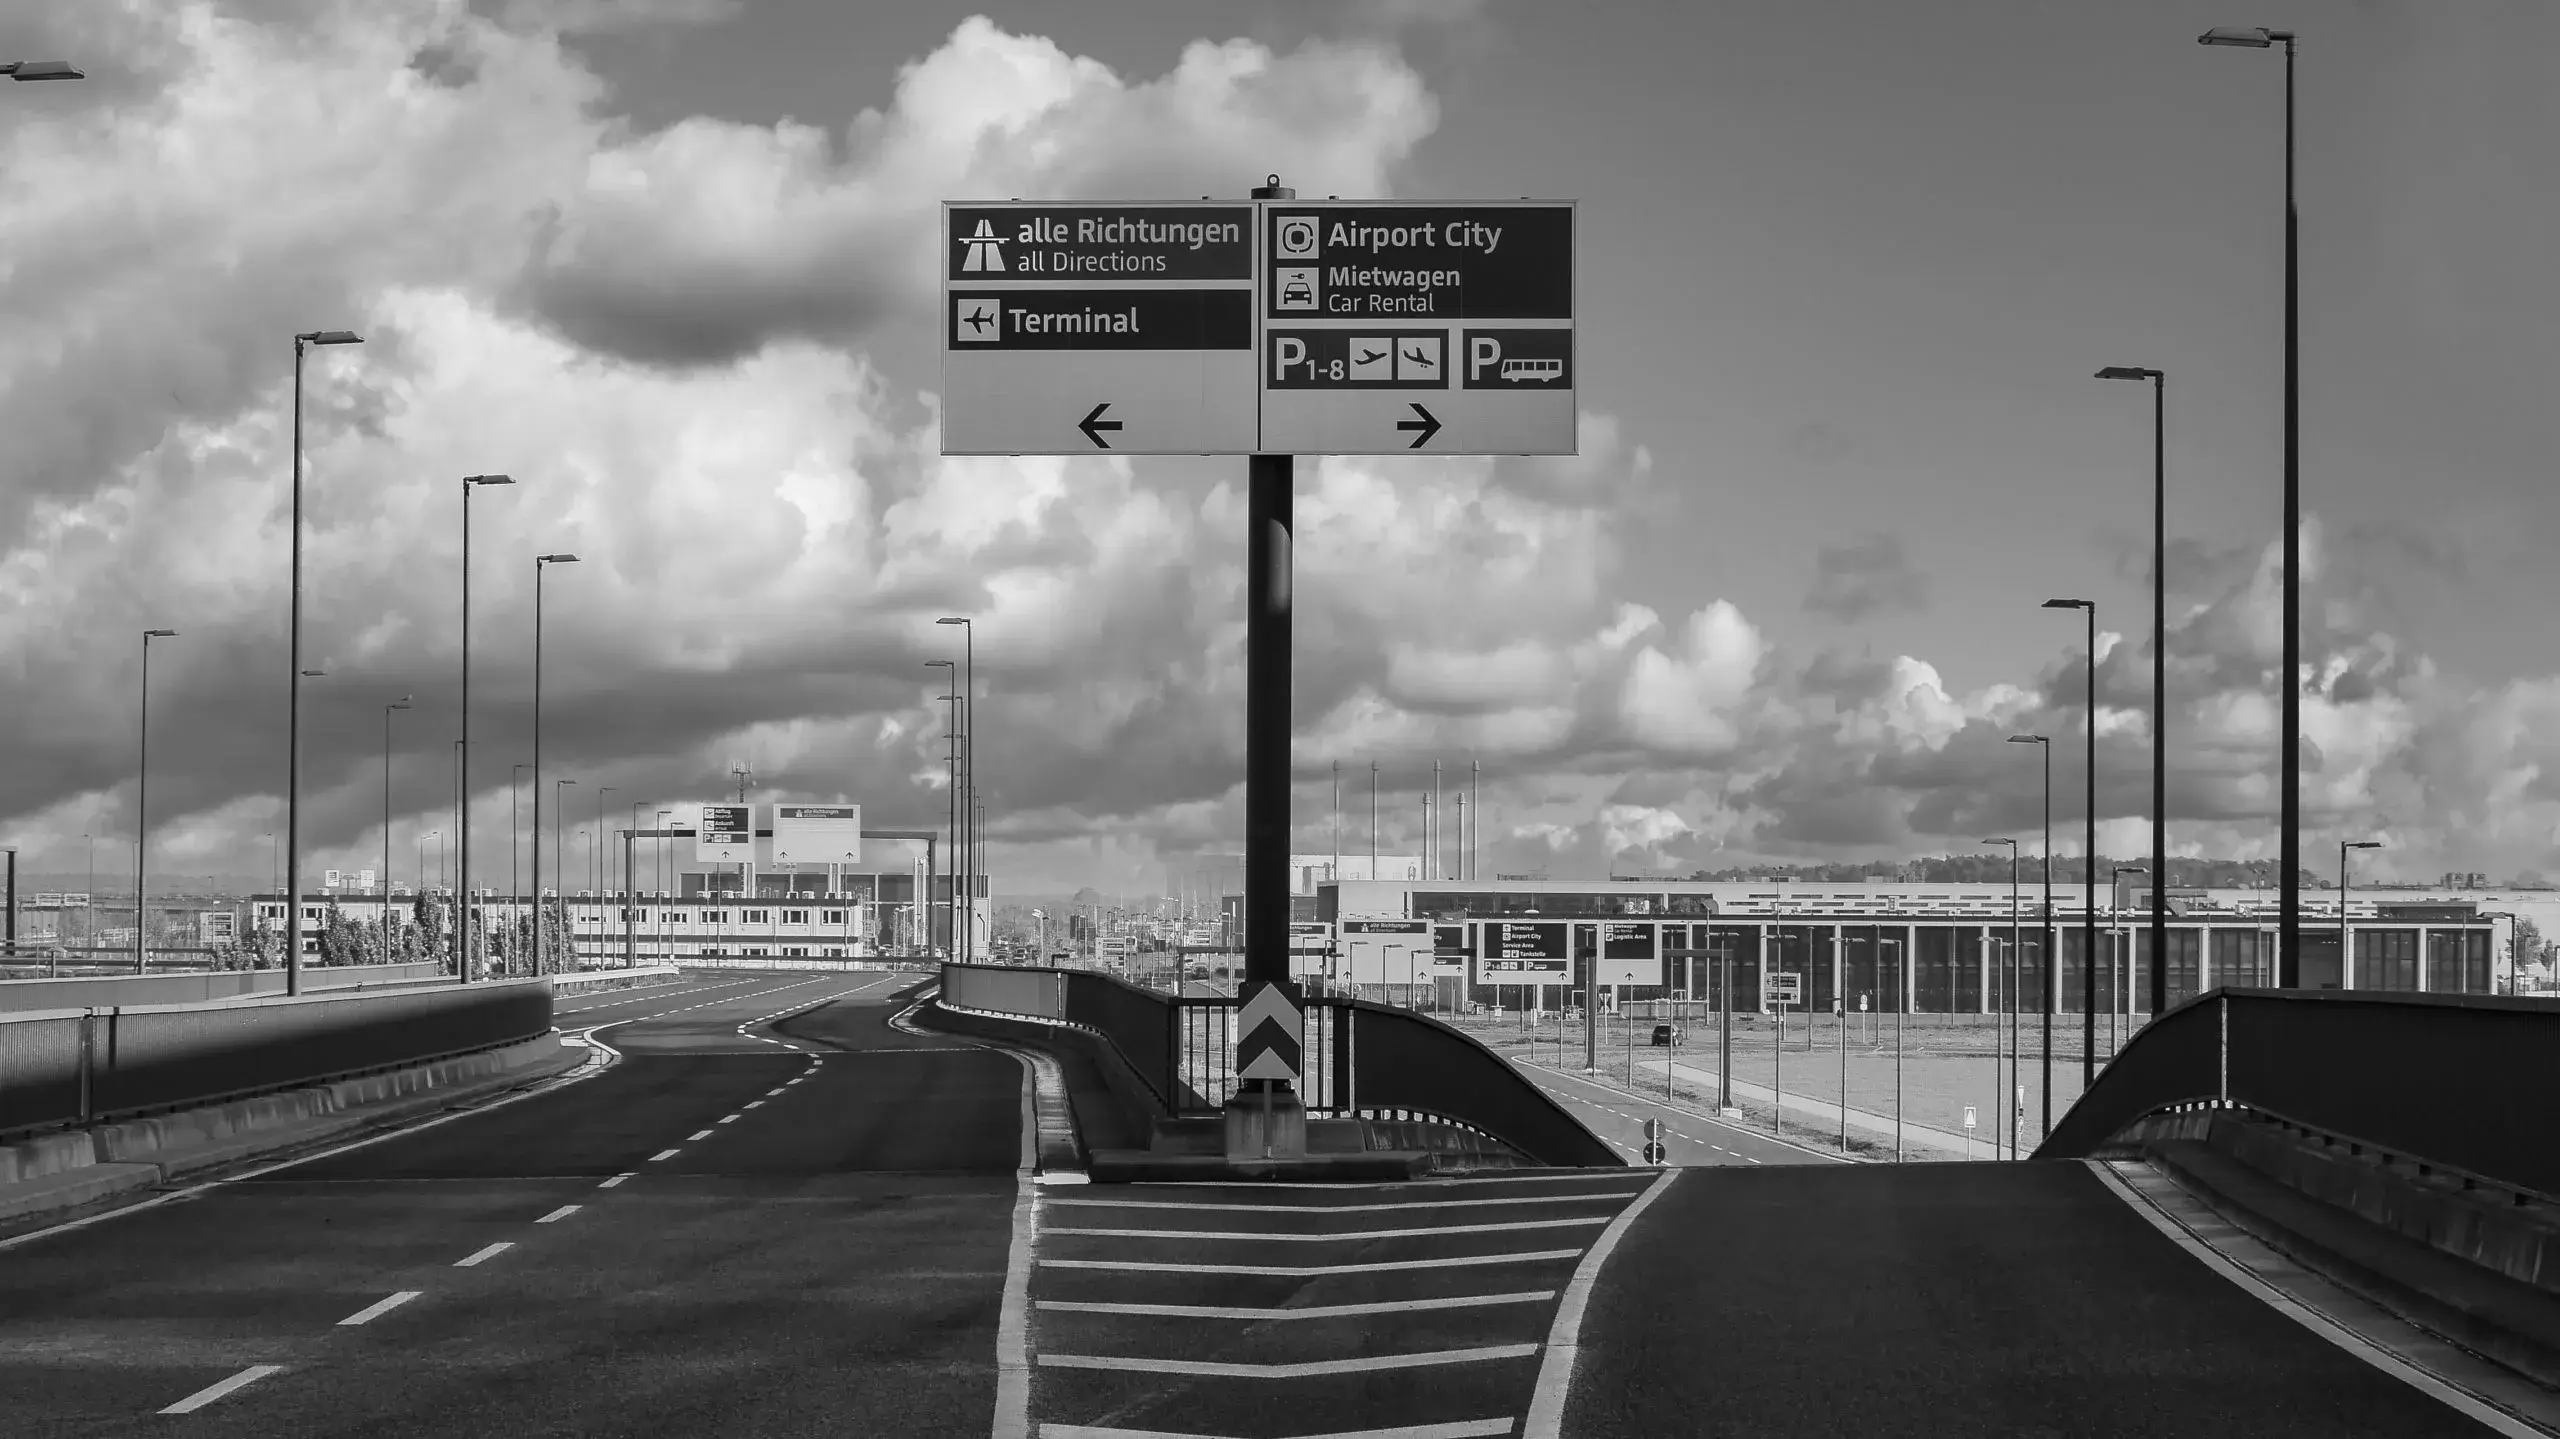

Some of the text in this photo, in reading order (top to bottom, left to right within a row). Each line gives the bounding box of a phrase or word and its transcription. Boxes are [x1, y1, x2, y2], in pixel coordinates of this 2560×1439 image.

[1018, 217, 1239, 250] alle Richtungen
[1328, 220, 1502, 254] Airport City
[1018, 250, 1167, 272] all Directions
[1328, 265, 1461, 292] Mietwagen
[1328, 293, 1434, 312] Car Rental
[1008, 307, 1140, 333] Terminal
[1471, 337, 1501, 381] P
